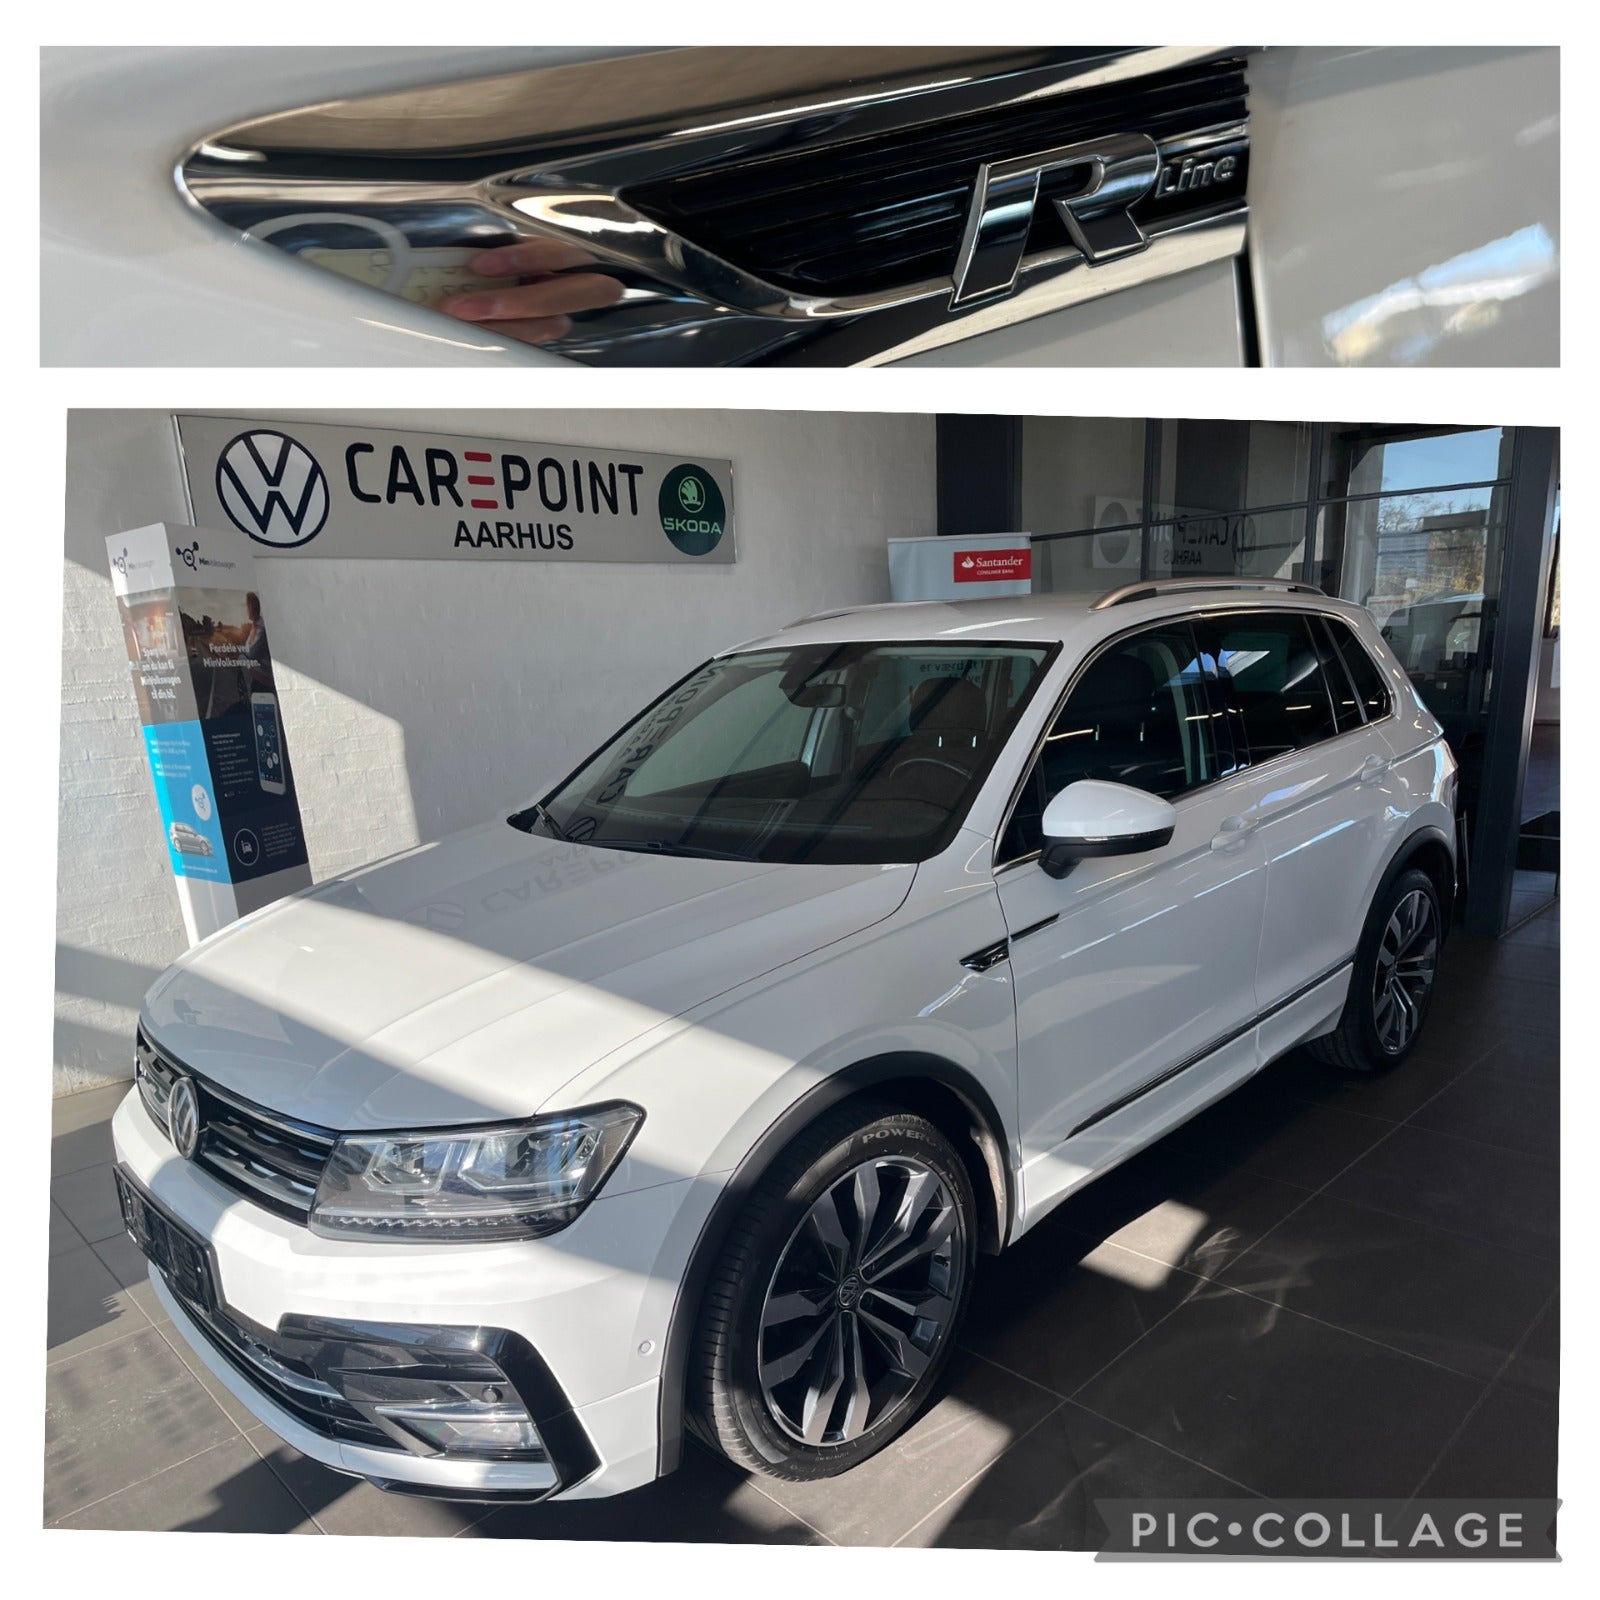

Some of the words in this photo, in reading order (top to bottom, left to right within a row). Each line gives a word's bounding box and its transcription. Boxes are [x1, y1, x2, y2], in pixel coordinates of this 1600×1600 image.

[949, 132, 1160, 311] R
[1155, 154, 1236, 199] Line
[345, 442, 644, 517] CAREPOINT
[454, 521, 574, 551] AARHUS
[976, 555, 1024, 568] Santander
[209, 643, 237, 654] Fordele
[862, 1128, 937, 1147] POWER
